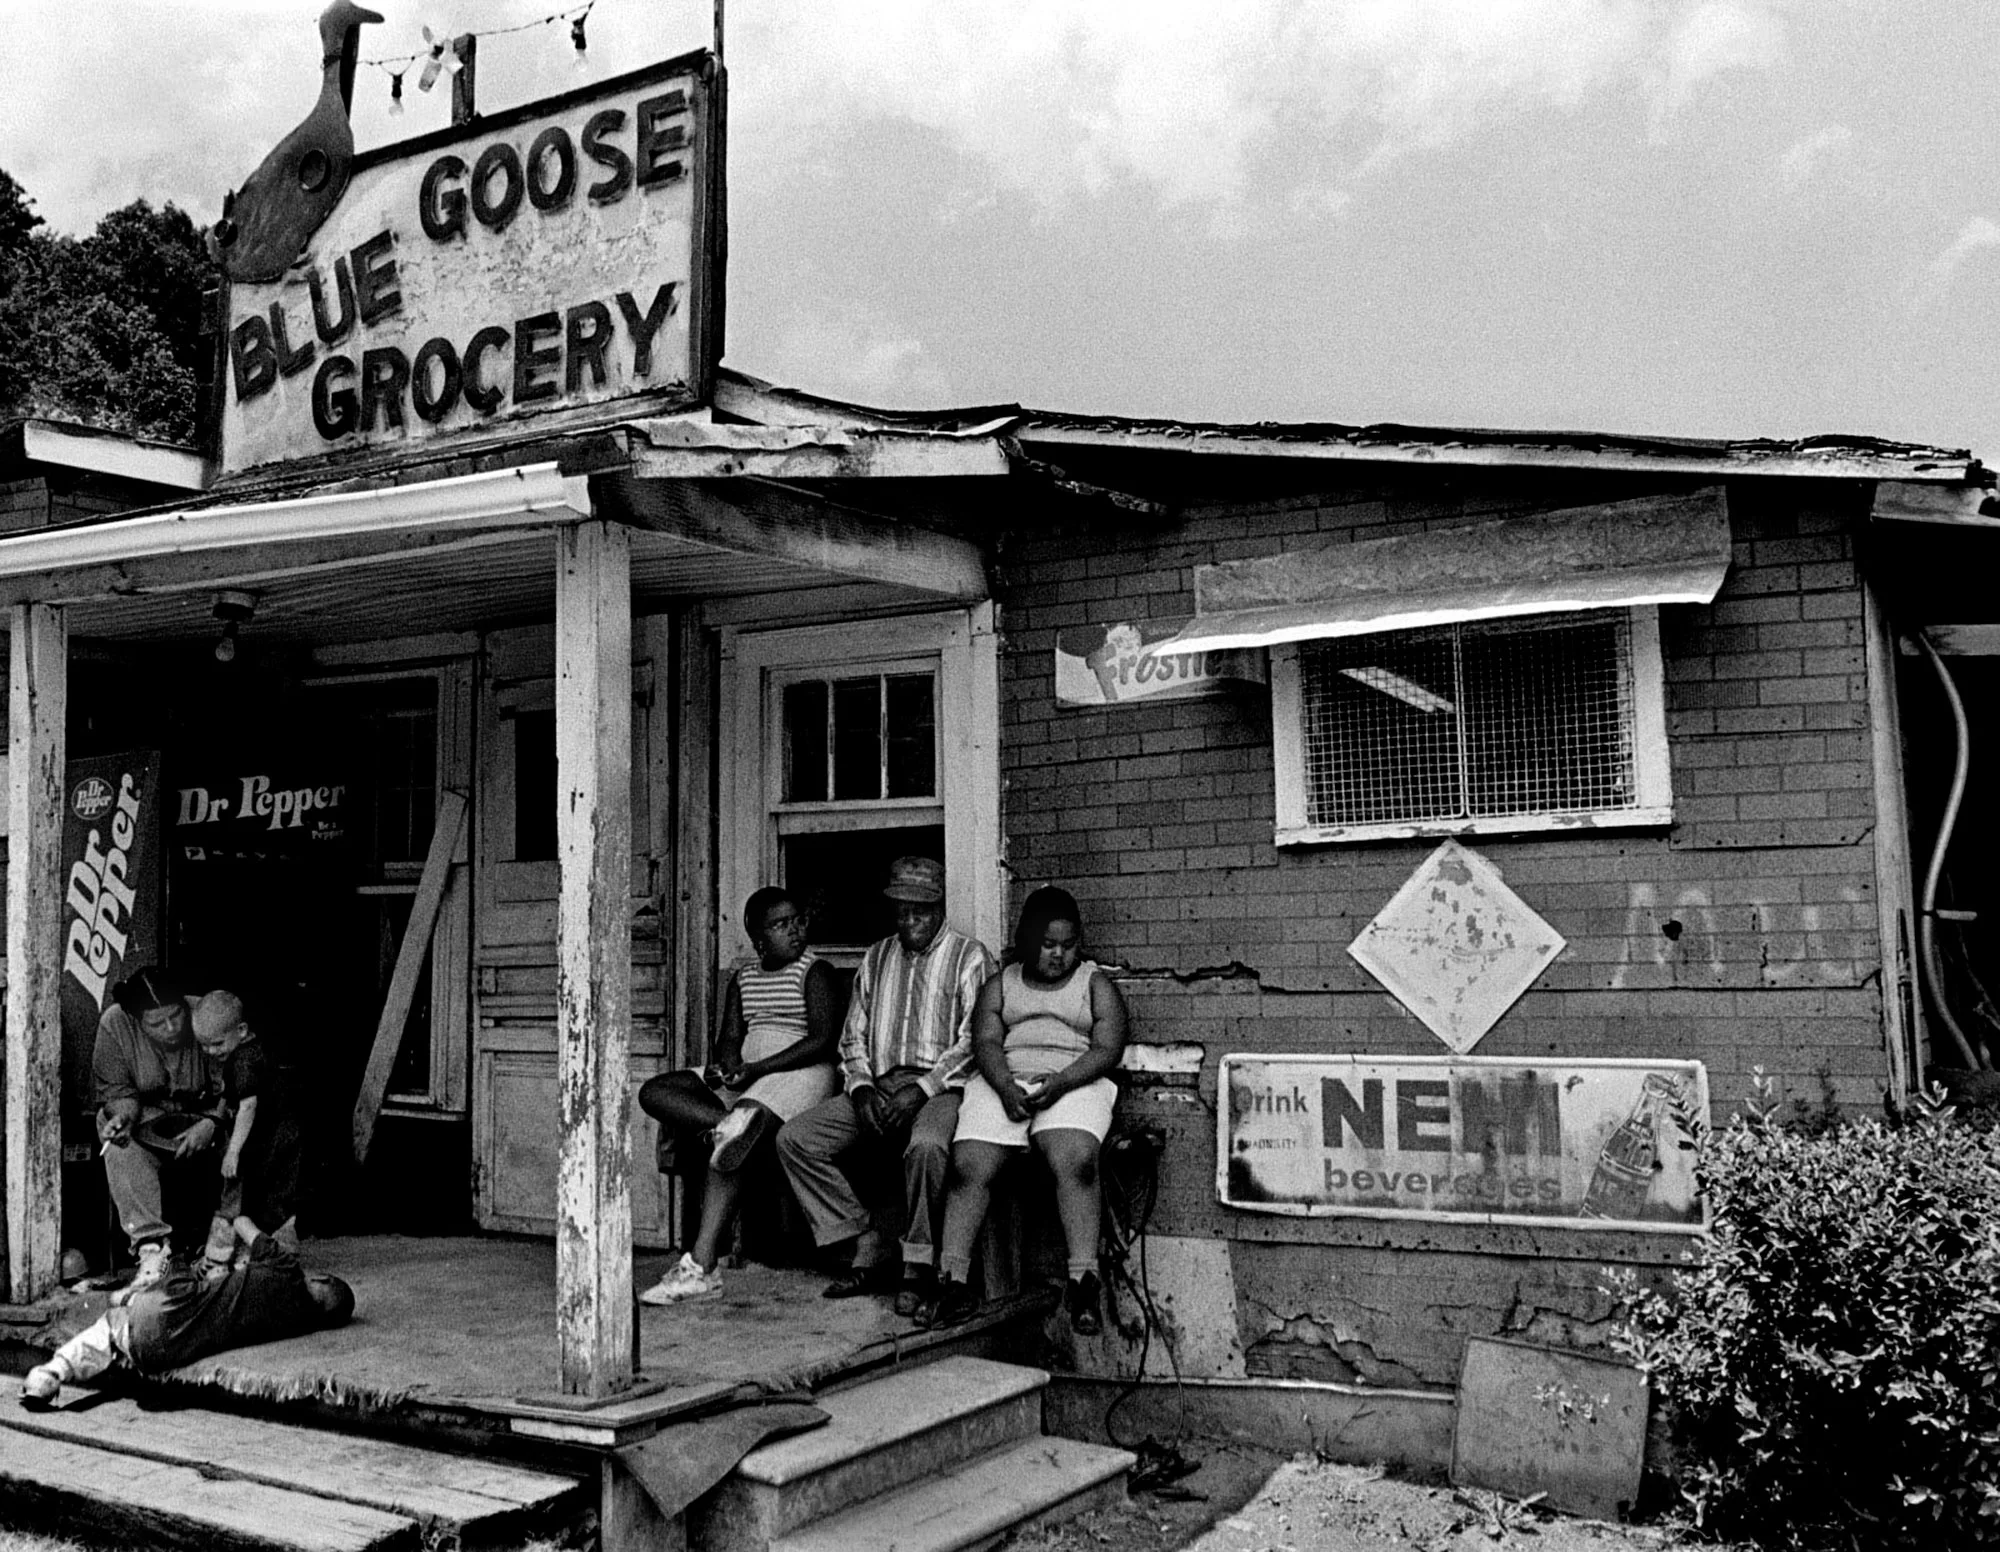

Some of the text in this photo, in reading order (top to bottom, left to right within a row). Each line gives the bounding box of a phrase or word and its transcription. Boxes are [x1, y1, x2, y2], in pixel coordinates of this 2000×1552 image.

[230, 89, 689, 402] BLUE GOOSE
[312, 282, 678, 440] GROCERY
[76, 790, 112, 815] Pepper
[88, 780, 105, 797] Dr
[176, 775, 345, 831] Dr Pepper
[64, 773, 140, 1014] Dr Pepper
[1232, 1078, 1562, 1157] Drink NEHI
[1324, 1159, 1562, 1202] beverages
